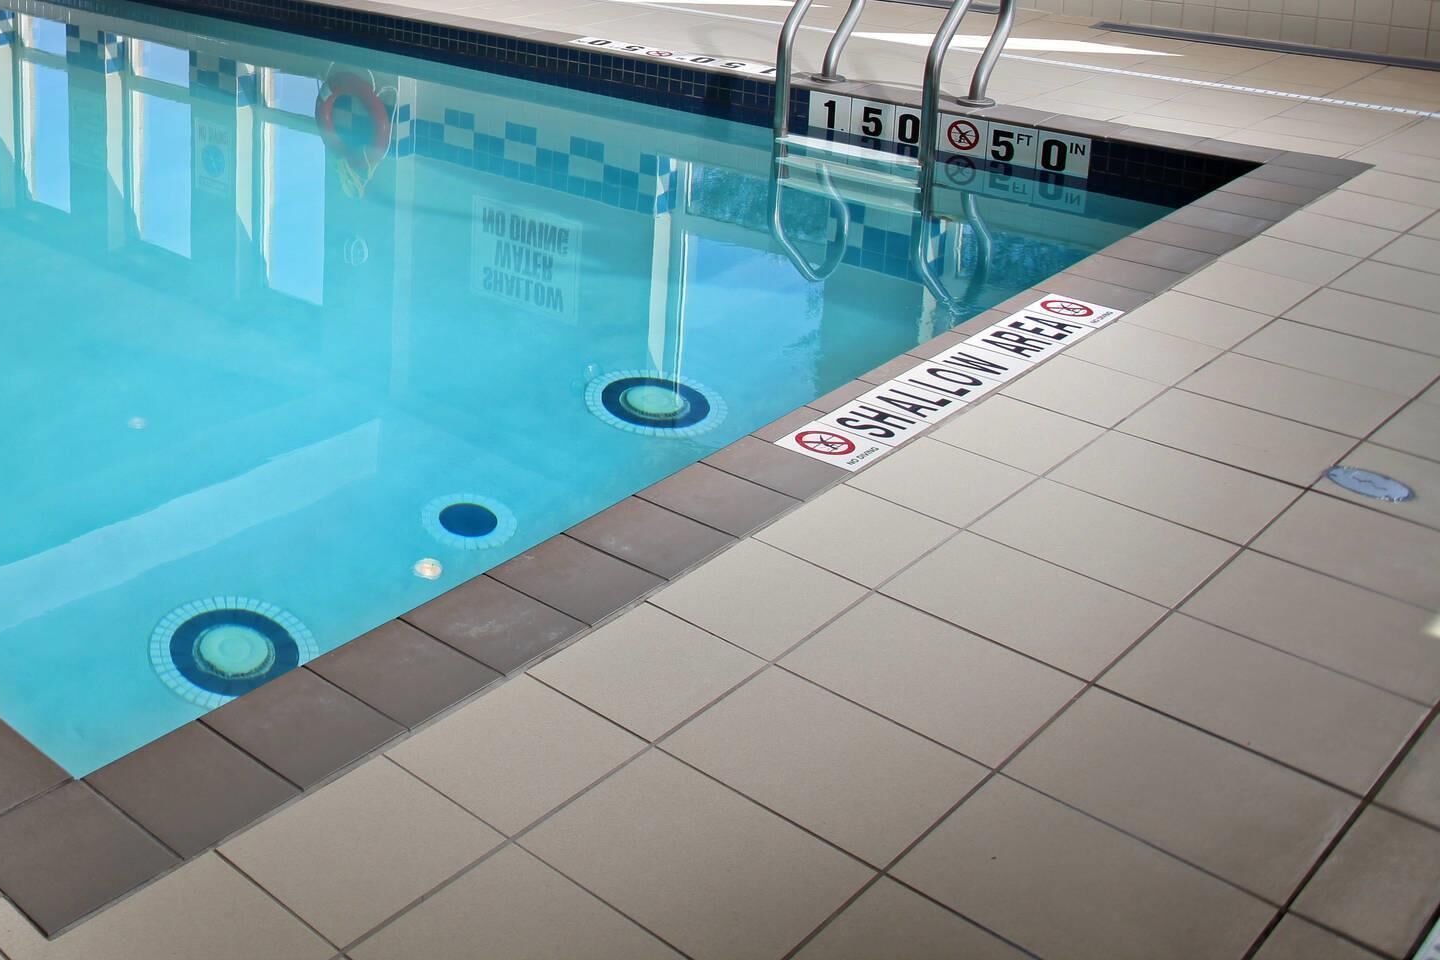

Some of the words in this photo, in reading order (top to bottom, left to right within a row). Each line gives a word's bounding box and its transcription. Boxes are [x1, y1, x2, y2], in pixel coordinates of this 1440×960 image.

[836, 352, 1008, 438] SHALLOW
[982, 316, 1082, 358] AREA
[847, 458, 859, 466] NO
[859, 447, 879, 460] DIVING
